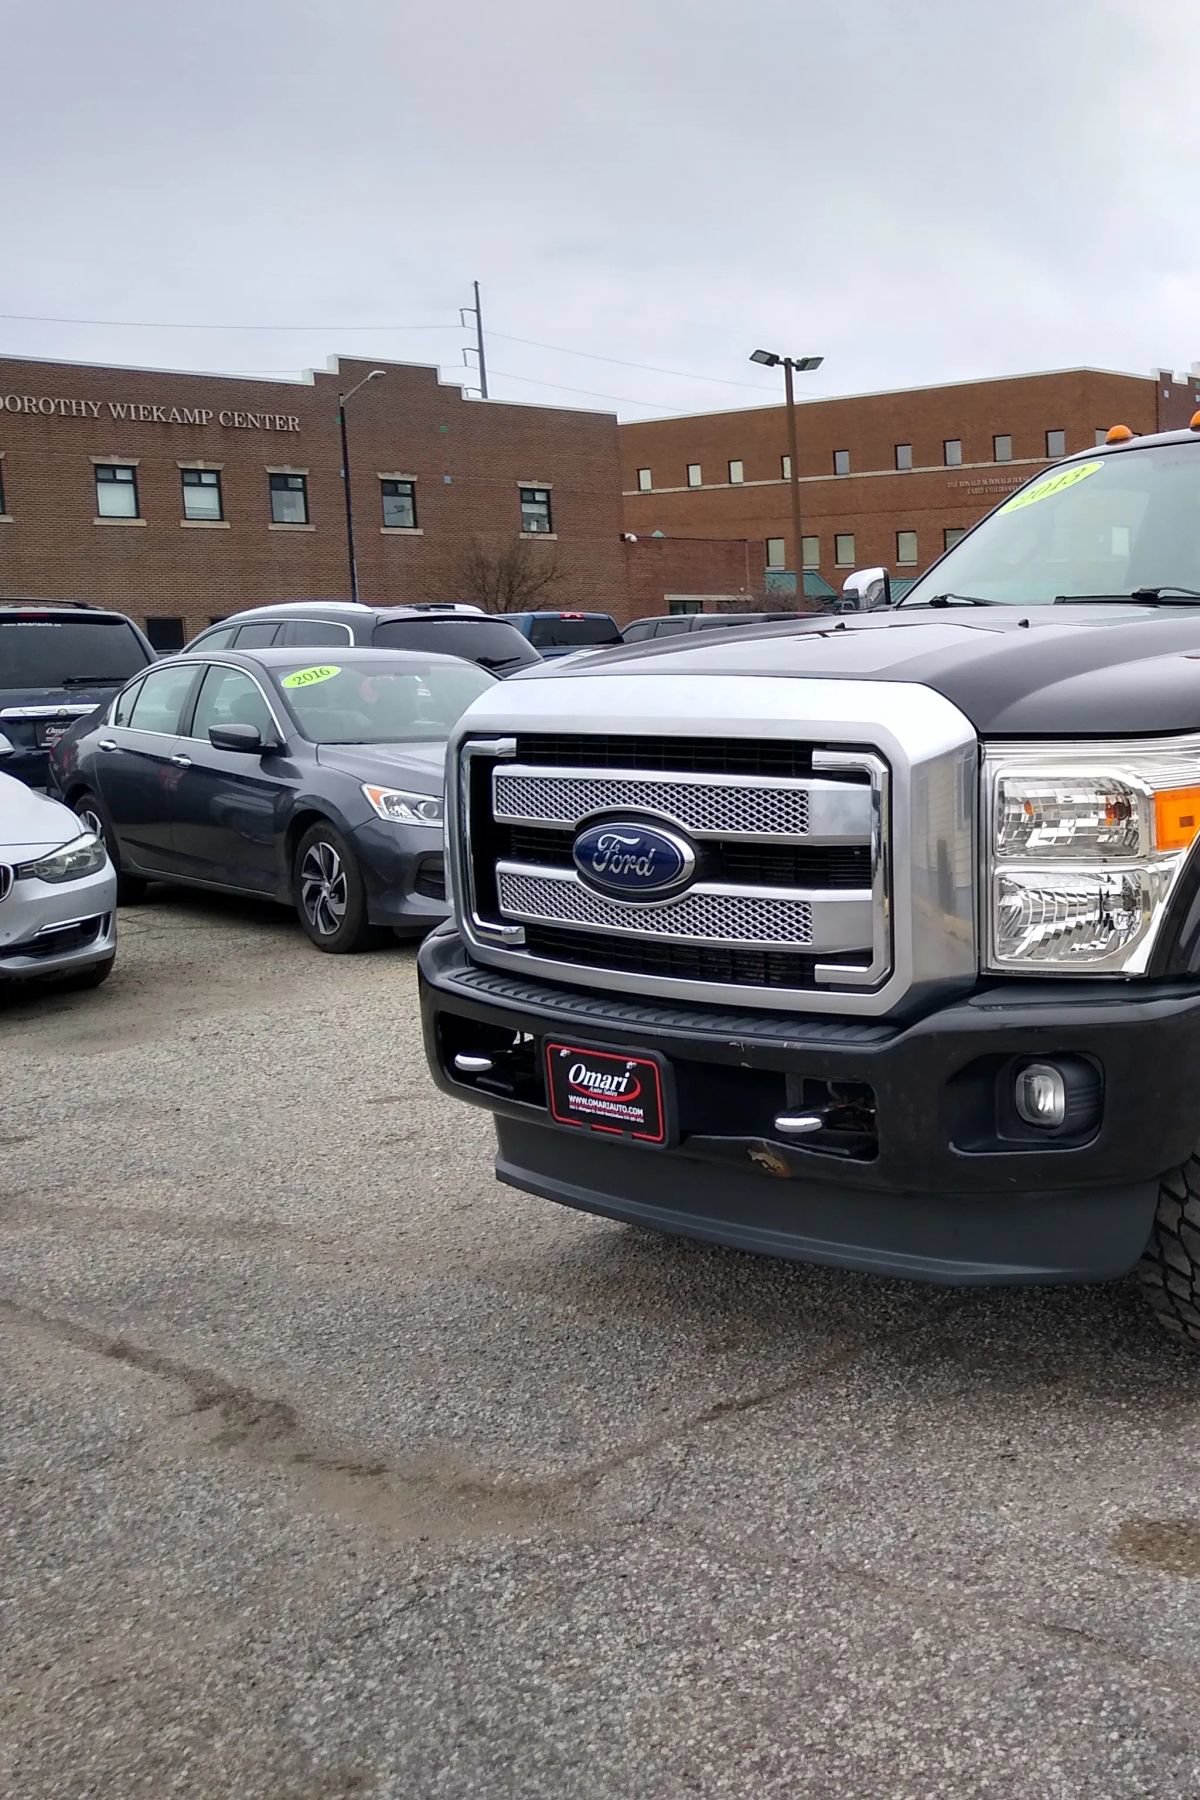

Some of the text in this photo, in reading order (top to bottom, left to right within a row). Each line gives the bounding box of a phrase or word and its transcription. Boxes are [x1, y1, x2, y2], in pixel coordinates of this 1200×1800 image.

[0, 395, 300, 432] OROTHY WIEKAMP CENTER
[292, 667, 331, 687] 2016
[592, 833, 656, 876] Ford
[568, 1063, 631, 1092] Omari
[588, 1086, 618, 1097] Auto Sales
